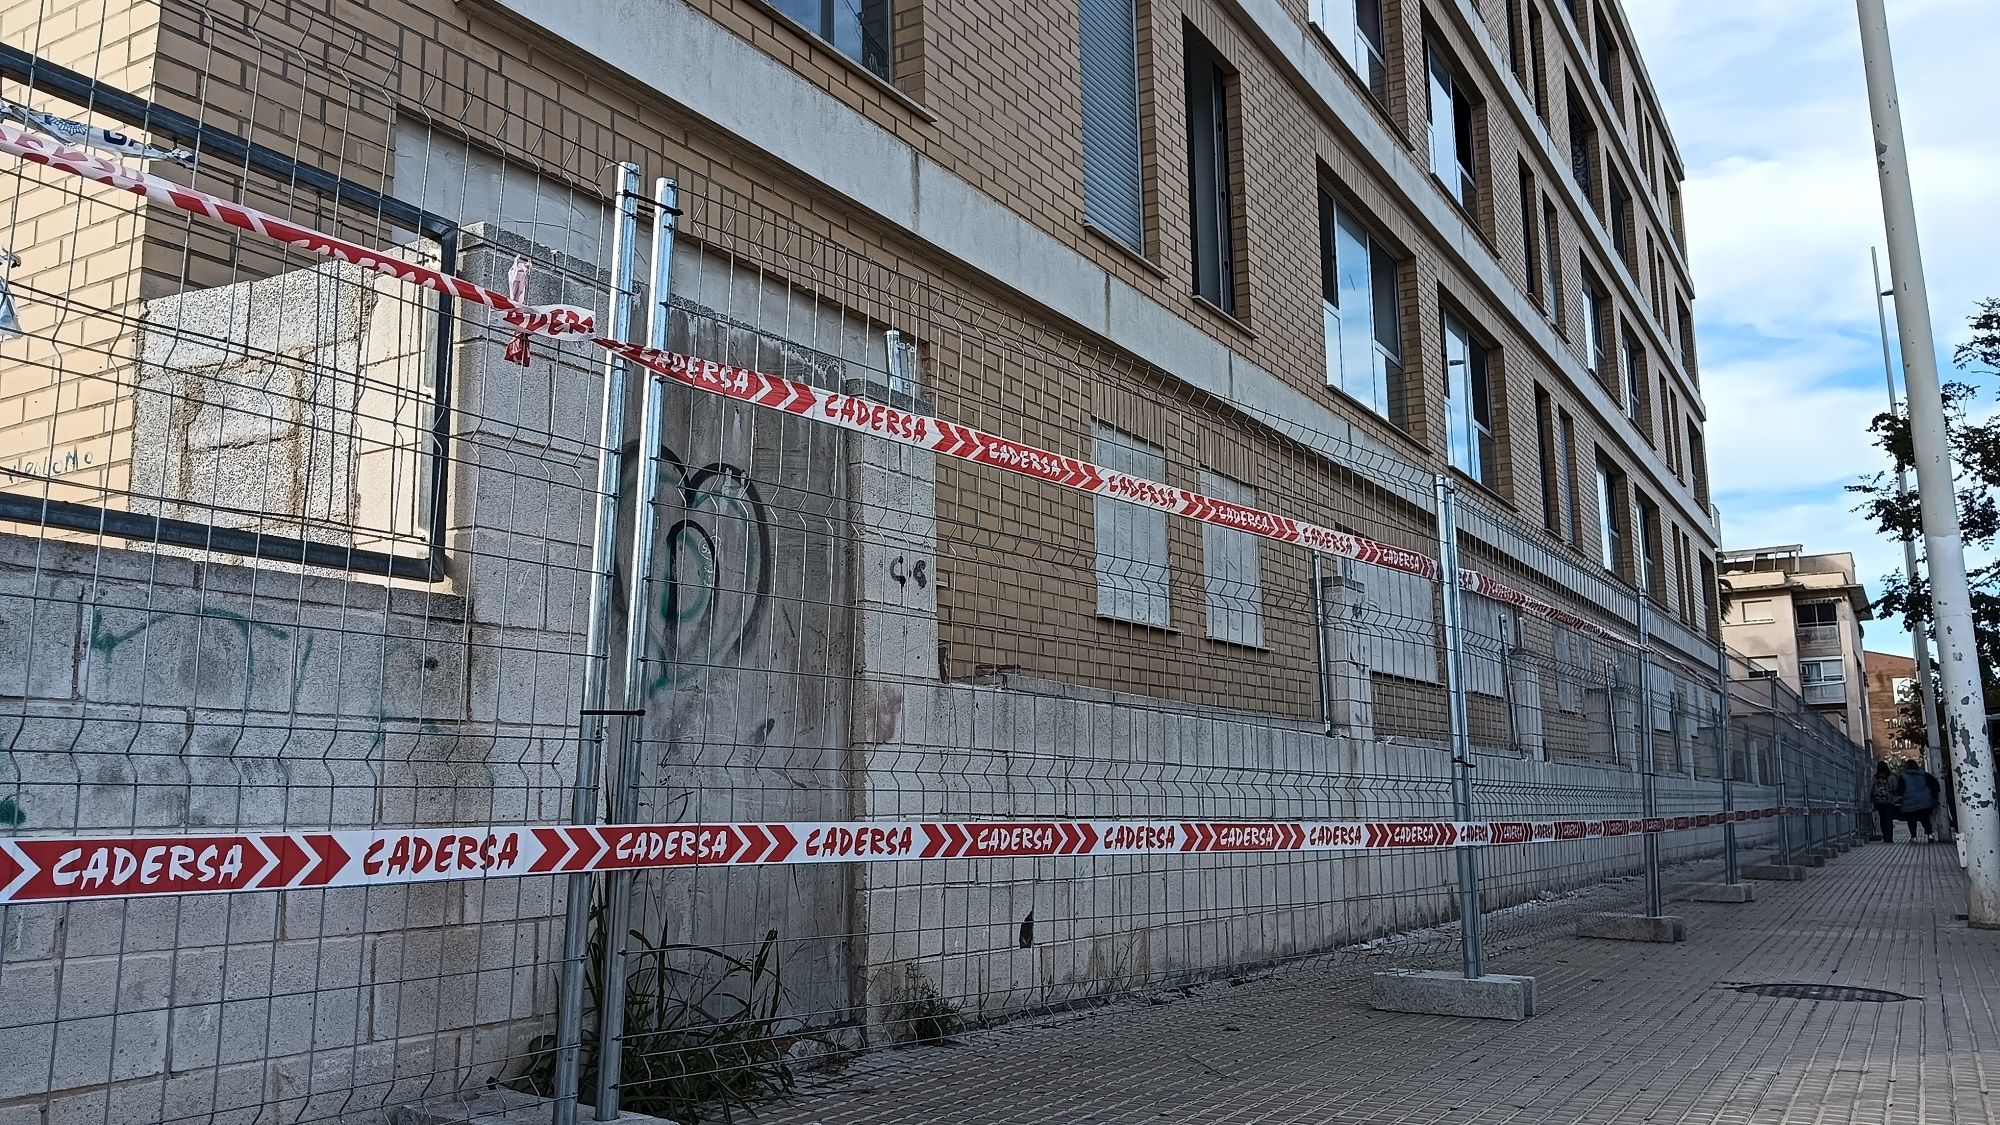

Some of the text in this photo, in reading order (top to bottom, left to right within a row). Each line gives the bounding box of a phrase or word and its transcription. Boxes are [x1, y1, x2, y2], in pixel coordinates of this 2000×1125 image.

[640, 347, 749, 394] CADERSA
[825, 394, 927, 442] CADERSA
[988, 442, 1062, 478] CADERSA
[1108, 475, 1177, 509] CADERSA
[1219, 505, 1271, 531] CADERSA
[1303, 528, 1353, 554] CADERSA
[1382, 549, 1420, 572] CADERSA
[52, 844, 243, 890] CADERSA
[363, 832, 519, 877] CADERSA
[615, 831, 728, 862] CADERSA
[806, 826, 912, 858] CADERSA
[977, 827, 1053, 852] CADERSA
[1103, 825, 1175, 850] CADERSA
[1220, 826, 1274, 847] CADERSA
[1310, 826, 1362, 847] CADERSA
[1393, 826, 1434, 843] CADERSA
